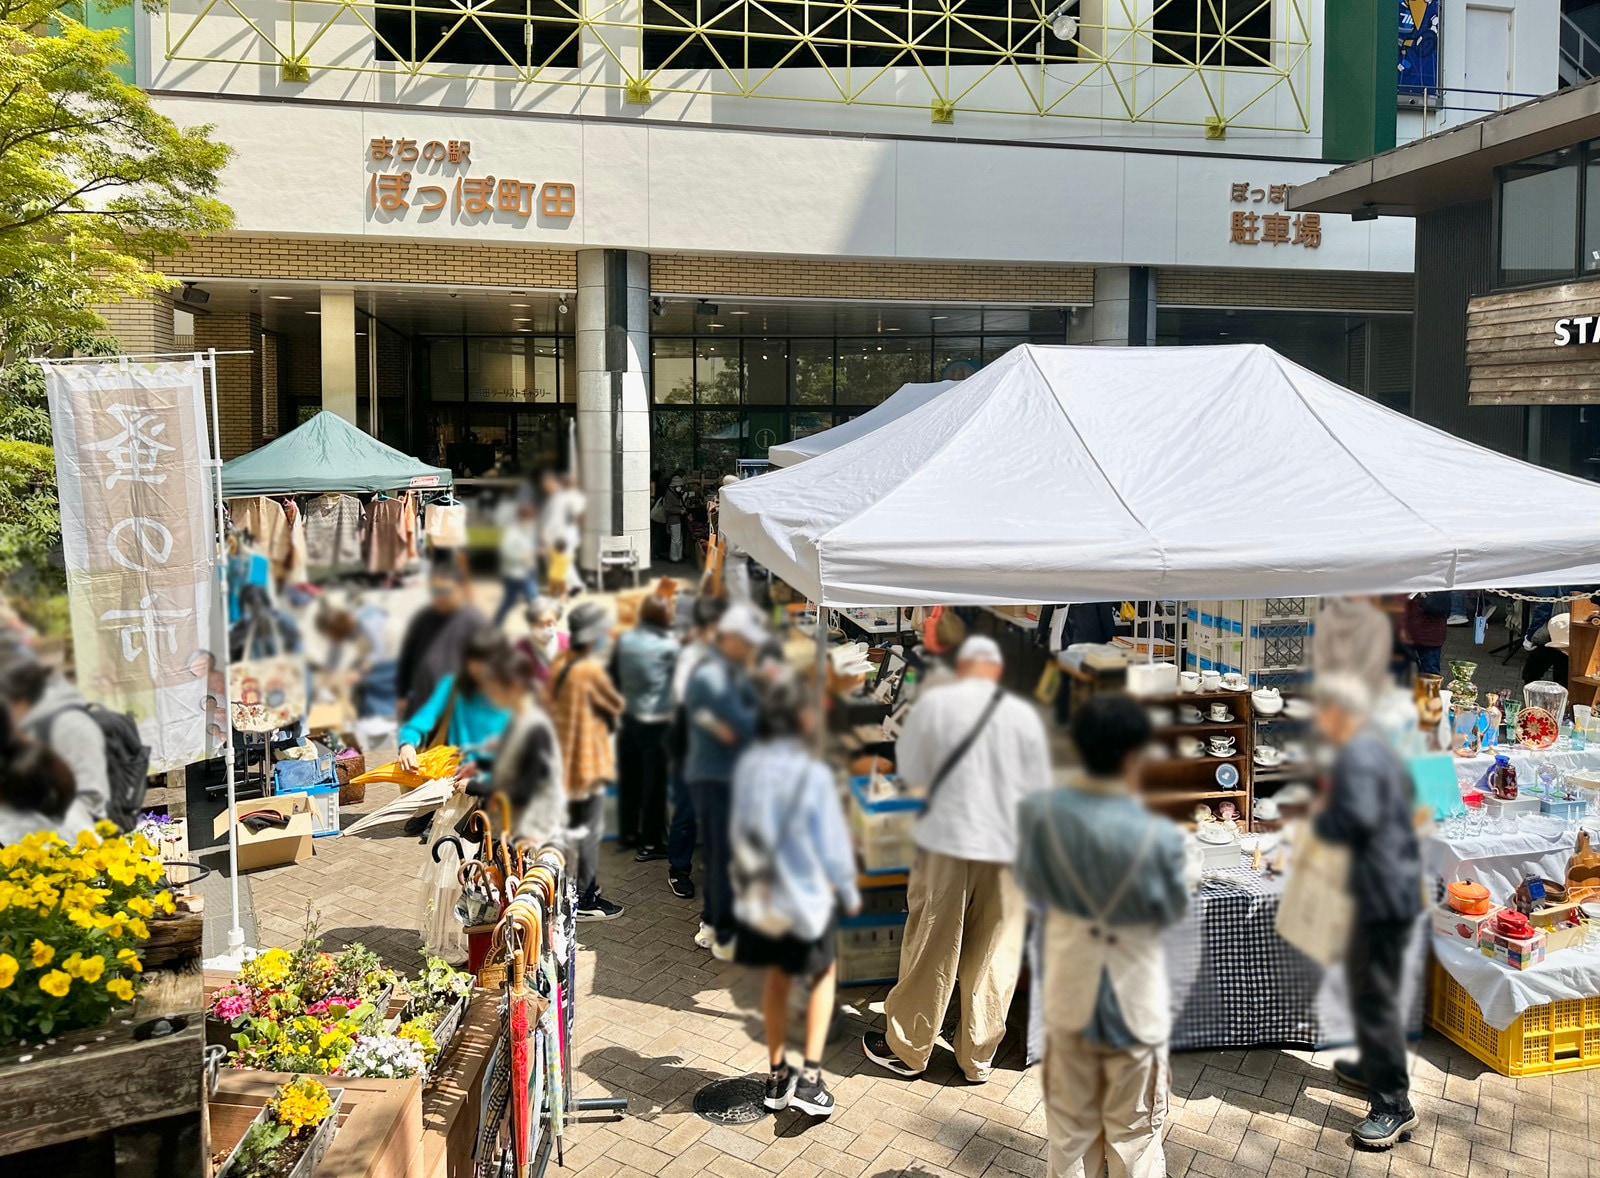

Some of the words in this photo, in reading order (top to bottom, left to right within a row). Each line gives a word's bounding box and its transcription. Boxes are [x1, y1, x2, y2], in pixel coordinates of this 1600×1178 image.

[371, 136, 471, 163] まちの駅
[371, 171, 575, 217] ぽっぽ町田
[1230, 211, 1322, 248] 駐車場
